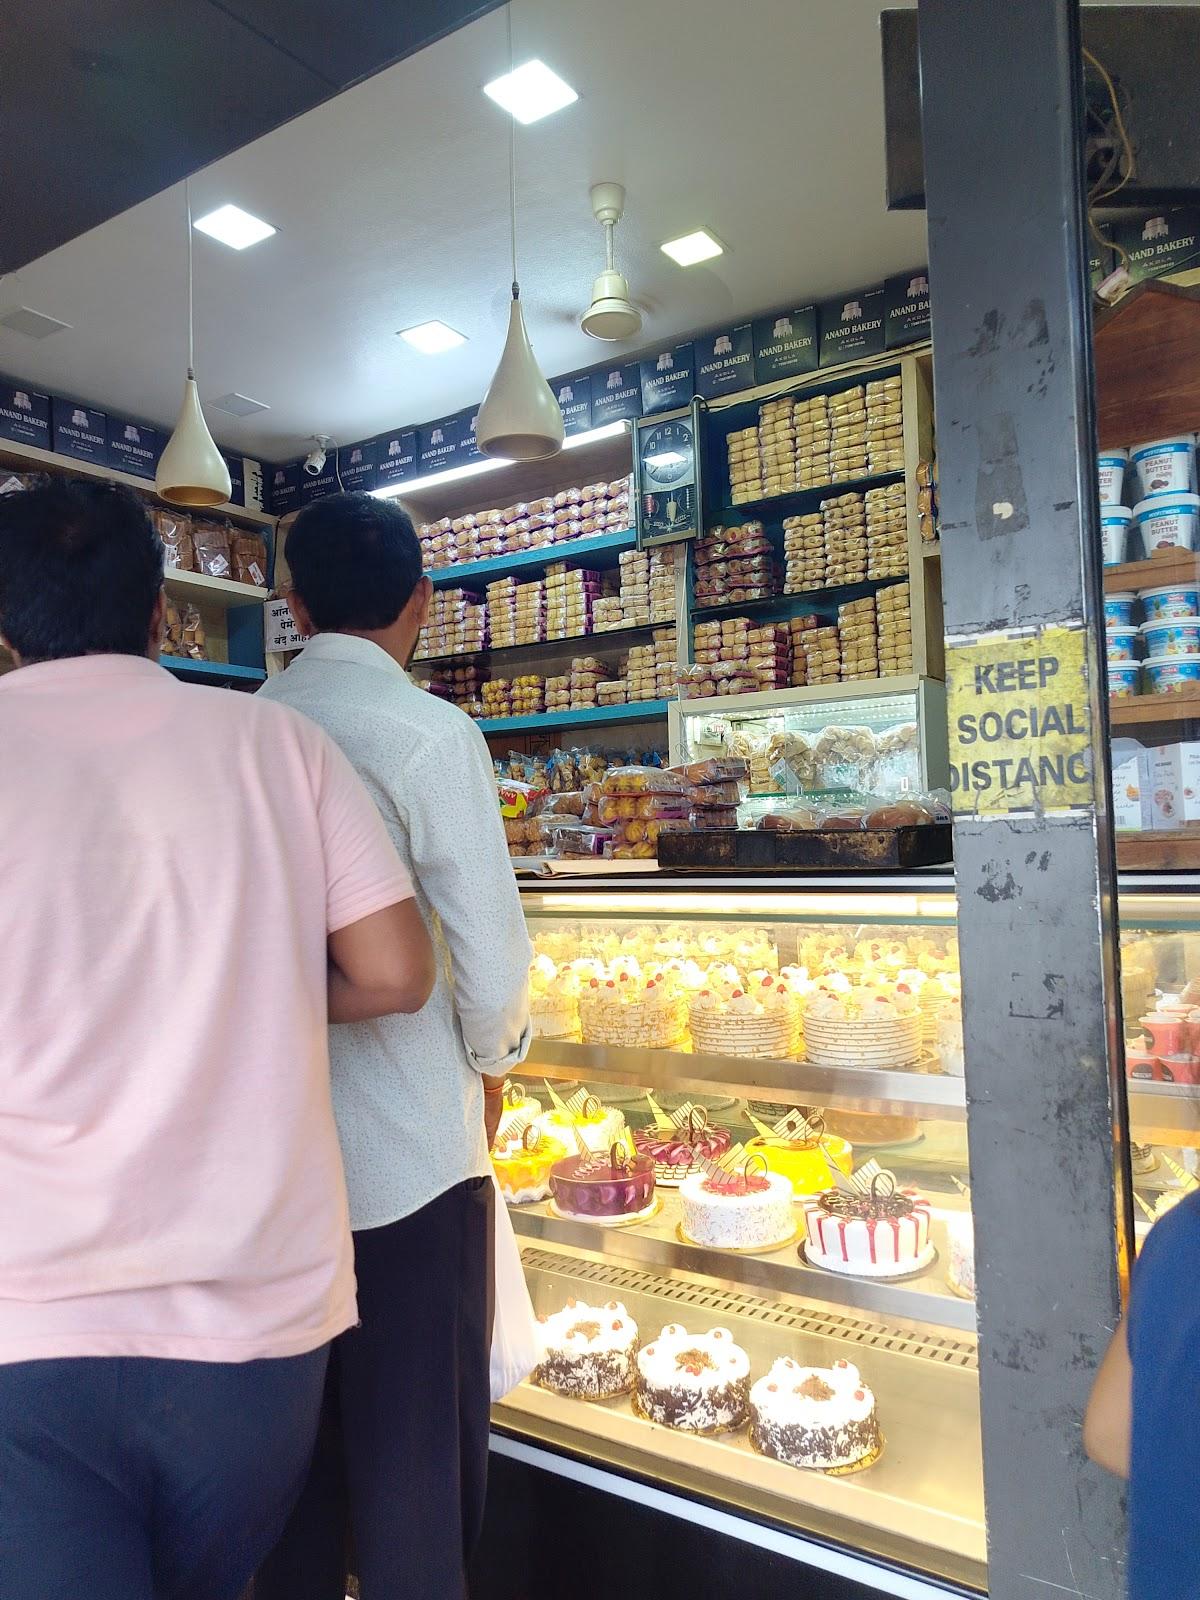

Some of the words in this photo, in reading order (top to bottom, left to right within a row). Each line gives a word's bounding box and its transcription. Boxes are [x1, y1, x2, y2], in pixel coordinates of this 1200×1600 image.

[1121, 247, 1154, 265] NAND
[1156, 235, 1196, 255] BAKERY
[889, 303, 917, 319] ANAND
[824, 327, 850, 341] ANAND
[851, 319, 882, 334] BAKERY
[758, 344, 783, 358] ANAND
[784, 336, 812, 352] BAKERY
[700, 361, 723, 375] ANAND
[723, 353, 751, 368] BAKERY
[645, 376, 665, 389] ANAND
[665, 369, 690, 383] BAKERY
[594, 394, 615, 407] ANAND
[614, 387, 638, 400] BAKERY
[565, 402, 588, 415] BAKERY
[0, 407, 22, 422] ANAND
[23, 413, 48, 429] BAKERY
[58, 425, 81, 438] ANAND
[81, 431, 105, 445] BAKERY
[656, 431, 662, 441] 11
[664, 426, 672, 436] 12
[682, 433, 689, 442] 2
[111, 440, 133, 453] ANAND
[133, 446, 154, 459] BAKERY
[421, 449, 437, 460] ANAND
[437, 443, 457, 456] BAKERY
[649, 441, 656, 450] 10
[355, 463, 374, 474] BAKERY
[379, 460, 395, 471] ANAND
[395, 455, 413, 467] BAKERY
[1144, 457, 1173, 468] PEANUT
[1145, 465, 1173, 474] BUTTER
[317, 476, 334, 487] BAKERY
[1150, 519, 1179, 528] PEANUT
[1151, 527, 1178, 536] BUTTER
[273, 634, 287, 646] बंद
[974, 656, 1060, 695] KEEP
[957, 703, 1086, 745] SOCIAL
